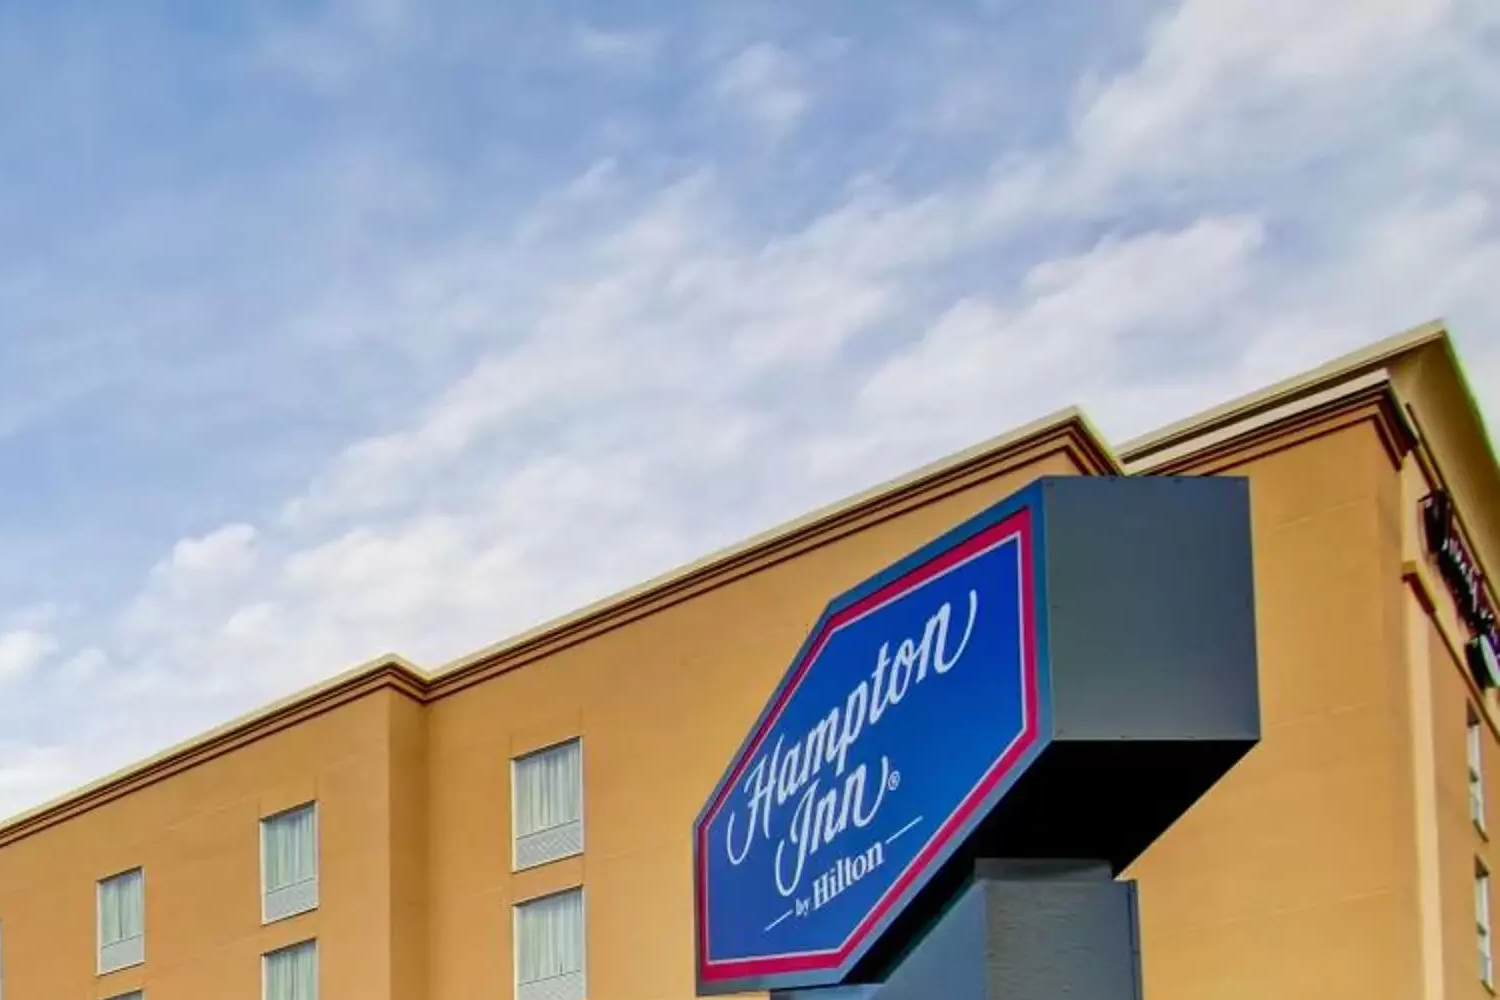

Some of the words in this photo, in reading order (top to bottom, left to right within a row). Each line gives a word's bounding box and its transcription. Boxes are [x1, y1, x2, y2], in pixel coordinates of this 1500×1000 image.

[727, 589, 978, 866] Hampton
[795, 898, 810, 917] by
[813, 841, 884, 911] Hilton
